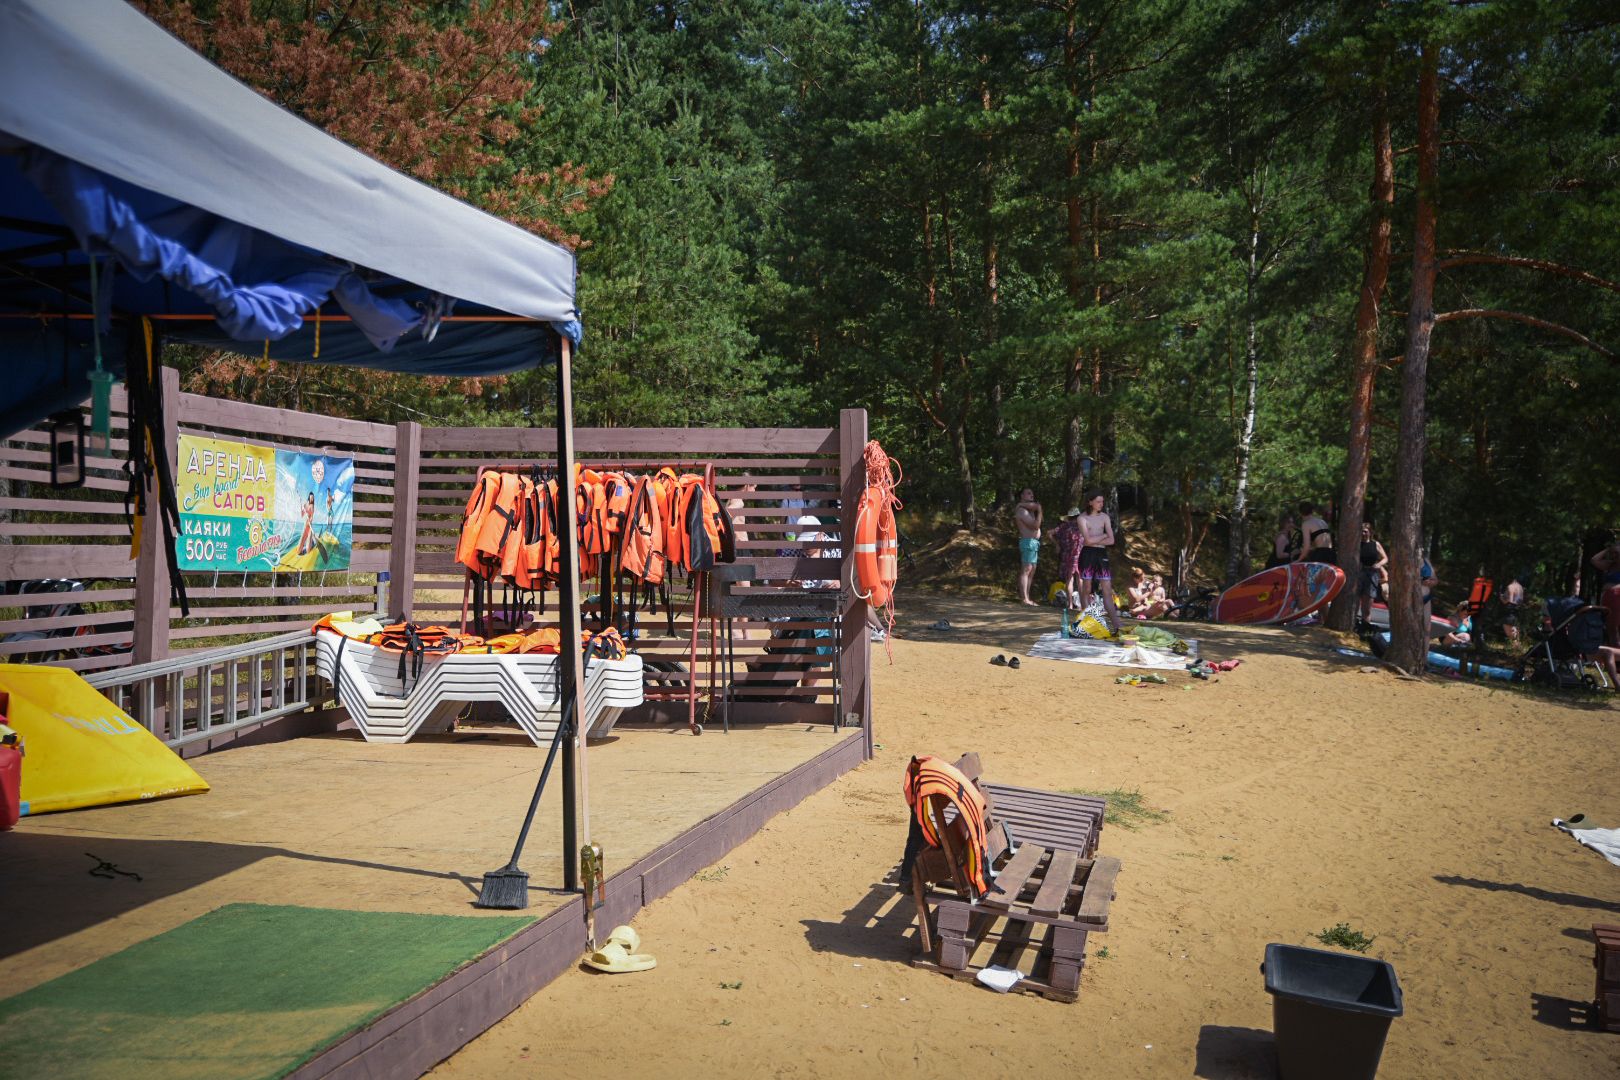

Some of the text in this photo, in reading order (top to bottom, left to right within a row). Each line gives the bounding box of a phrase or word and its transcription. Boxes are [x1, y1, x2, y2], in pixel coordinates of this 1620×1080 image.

[186, 448, 267, 482] АРЕНДА
[213, 492, 265, 511] САПОВ
[185, 520, 231, 537] КАЯКИ
[186, 538, 215, 561] 500
